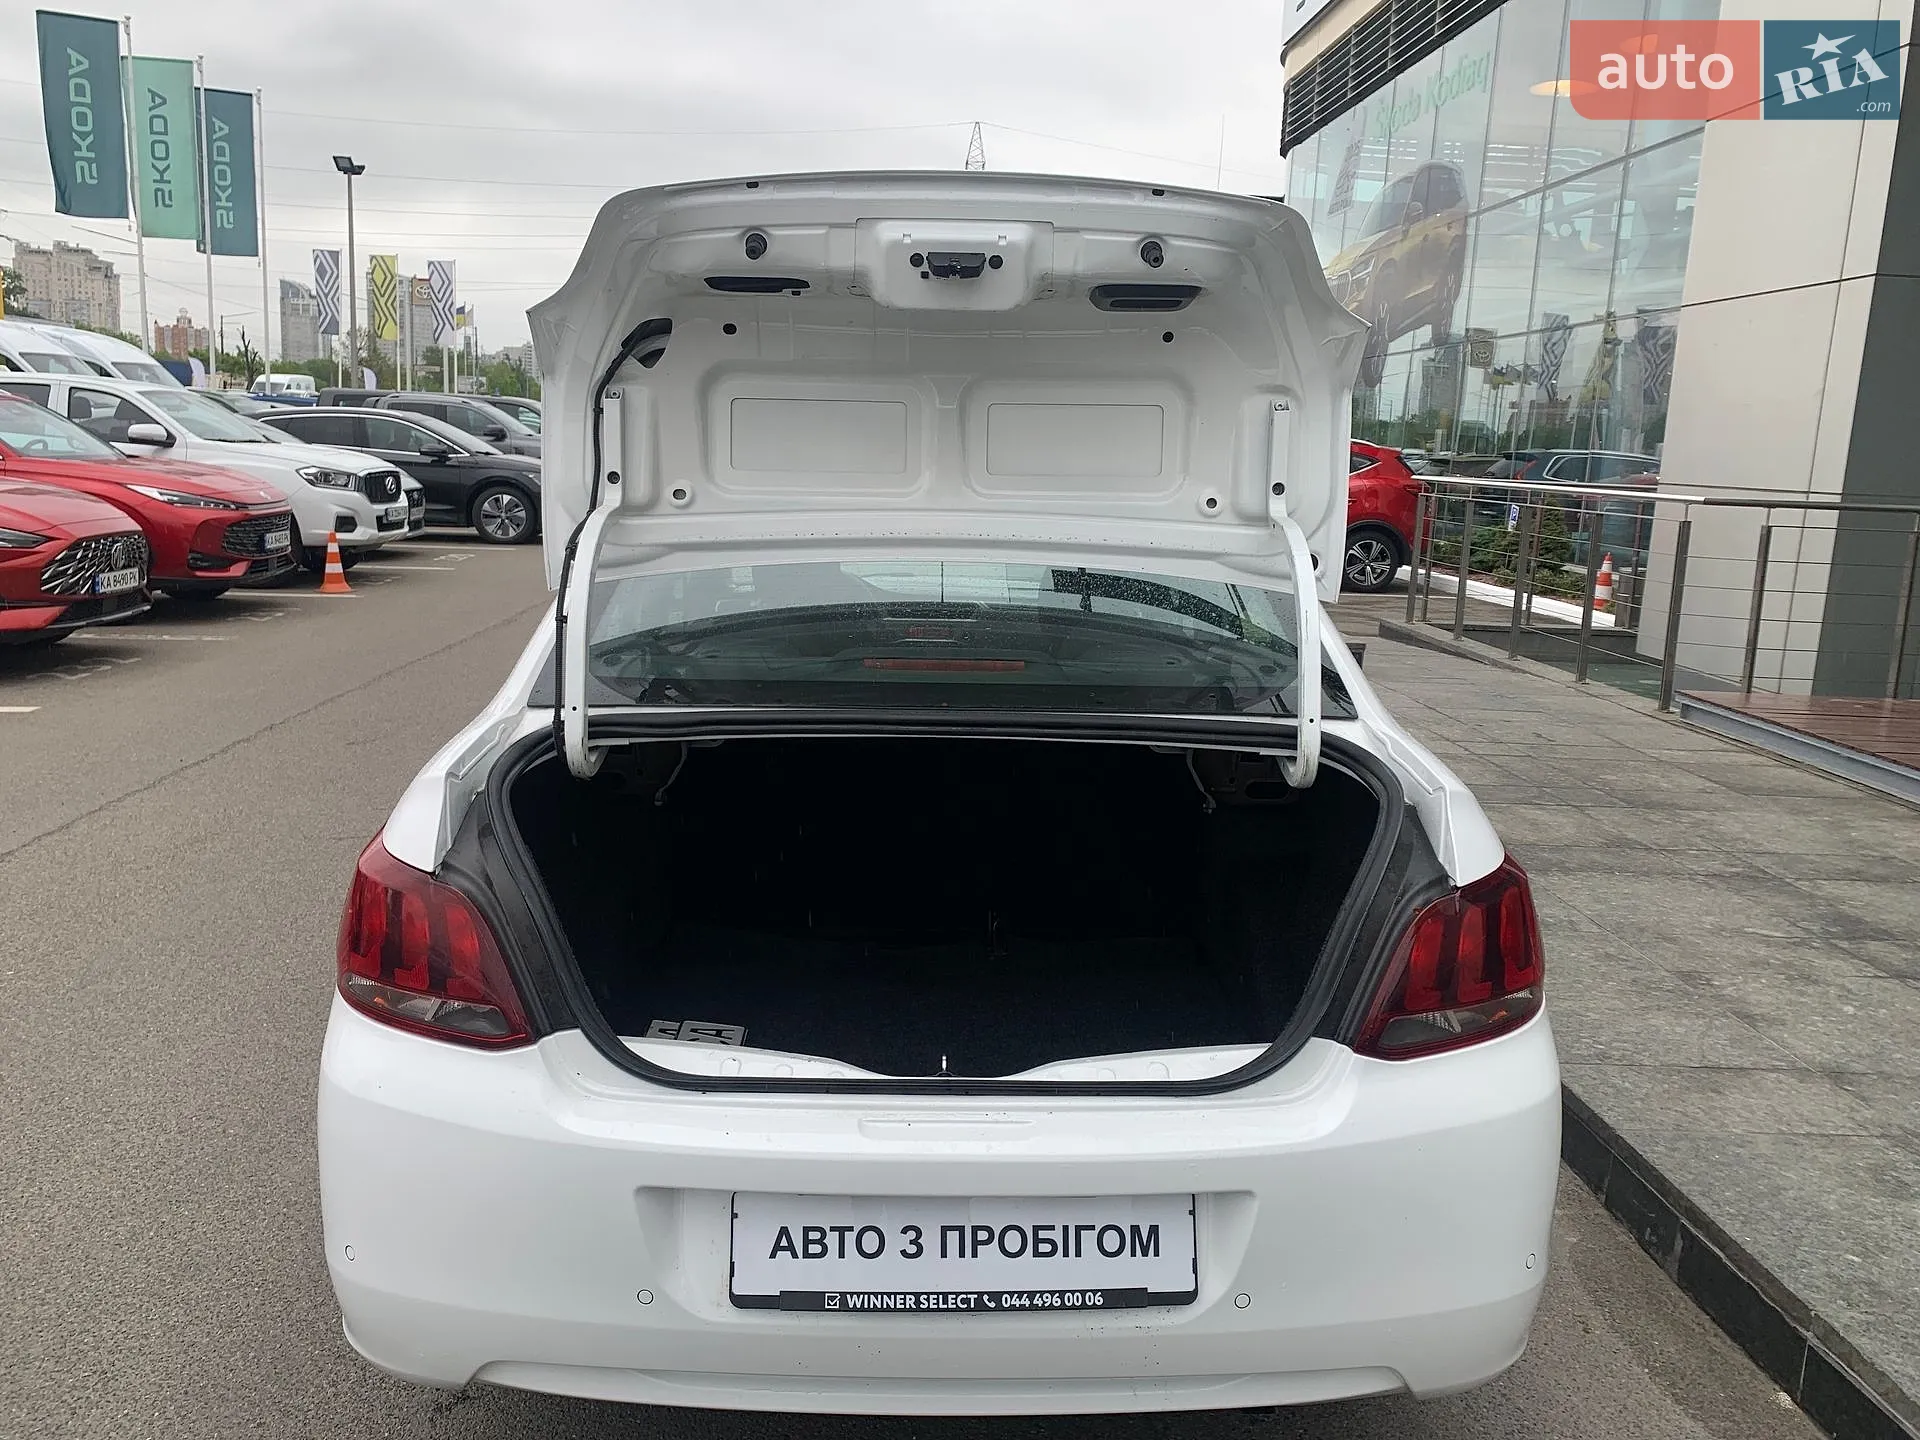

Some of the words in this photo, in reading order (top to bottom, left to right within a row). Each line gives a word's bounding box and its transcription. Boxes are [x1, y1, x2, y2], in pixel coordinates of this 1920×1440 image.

[769, 1224, 886, 1259] АВТО
[940, 1224, 1160, 1259] ПРОБІГОМ
[846, 1294, 917, 1308] WINNER
[919, 1294, 978, 1308] SELECT
[1001, 1293, 1030, 1308] 044
[1032, 1292, 1061, 1307] 496
[1064, 1292, 1082, 1307] 00
[1085, 1291, 1104, 1306] 06
